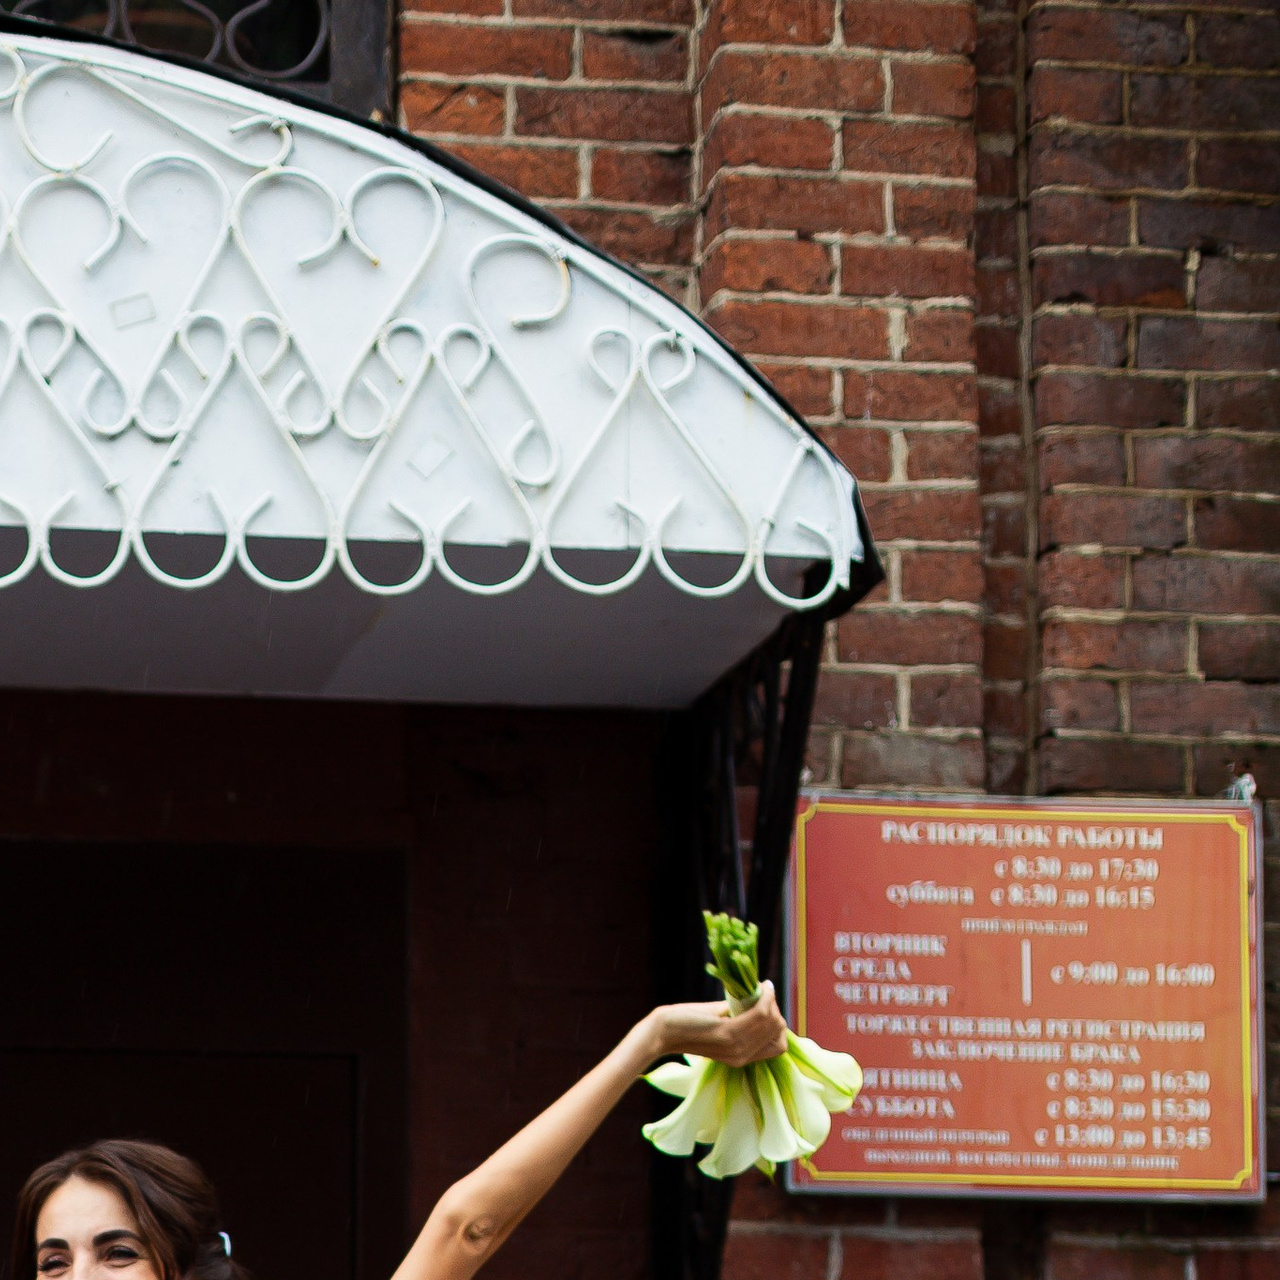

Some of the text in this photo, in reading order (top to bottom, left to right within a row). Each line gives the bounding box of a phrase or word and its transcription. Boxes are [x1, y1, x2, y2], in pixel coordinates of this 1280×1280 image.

[881, 820, 1164, 850] РАСПОРЯДОК РАБОТЫ
[1011, 855, 1061, 880] 8:30
[1065, 861, 1094, 881] до
[1098, 857, 1160, 882] 17:30
[886, 880, 975, 909] суббота
[1007, 882, 1058, 908] 8:30
[1062, 889, 1090, 908] до
[1095, 885, 1156, 910] 16:15
[833, 931, 948, 957] ВТОРНИК
[832, 956, 912, 981] СРЕДА
[1068, 960, 1119, 986] 9:00
[1121, 966, 1151, 987] до
[1155, 962, 1216, 988] 16:00
[1069, 1042, 1142, 1065] БРАКА
[863, 1067, 963, 1093] ЯТНИЦА
[1063, 1068, 1114, 1093] 8:30
[1118, 1073, 1146, 1094] до
[1150, 1069, 1211, 1095] 16:30
[1064, 1095, 1115, 1121] 8:30
[1119, 1101, 1147, 1122] до
[1151, 1097, 1211, 1123] 15:30
[1054, 1123, 1115, 1149] 13:00
[1119, 1129, 1147, 1150] до
[1151, 1125, 1211, 1151] 13:45
